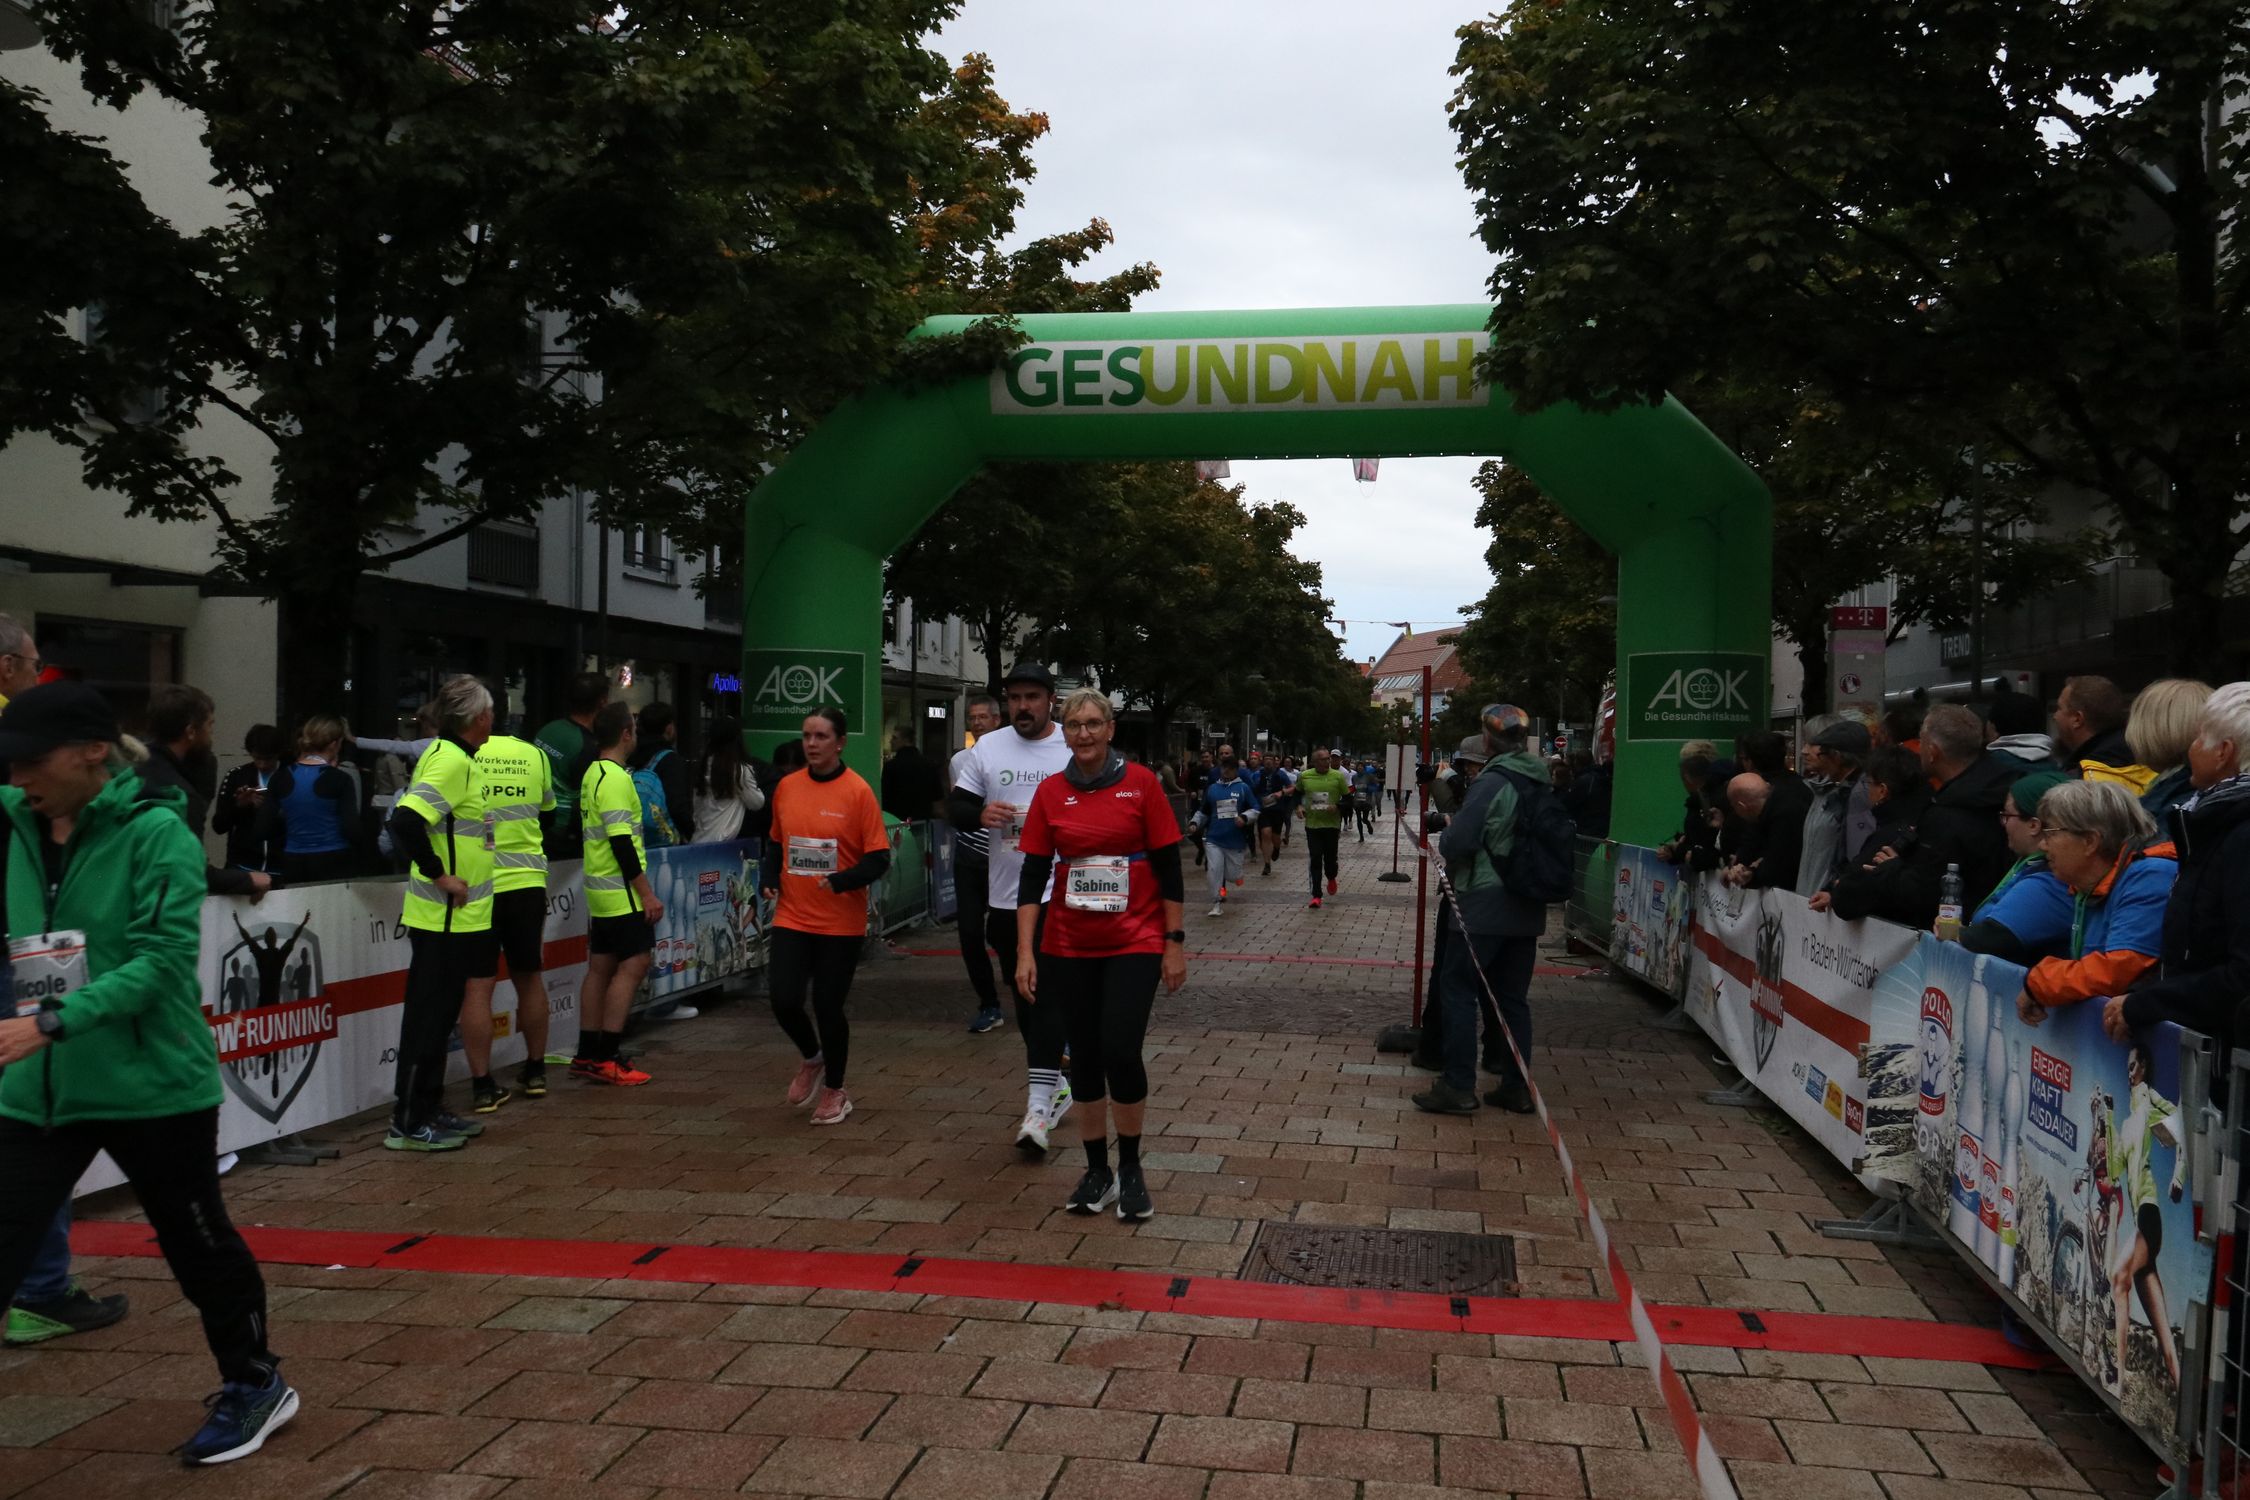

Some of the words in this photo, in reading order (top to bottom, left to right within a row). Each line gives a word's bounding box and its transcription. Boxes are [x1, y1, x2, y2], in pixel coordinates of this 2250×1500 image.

[1005, 339, 1474, 408] GESUNDNAH
[755, 665, 845, 704] AOK
[1648, 668, 1750, 710] AOK
[1645, 711, 1659, 721] Die
[493, 785, 526, 797] PCH
[792, 857, 830, 869] Kathrin
[1075, 879, 1119, 892] Sabine
[370, 913, 386, 944] in
[2033, 1050, 2070, 1088] ENERGIE
[2031, 1075, 2061, 1109] KRAFT
[2029, 1101, 2075, 1147] AUSDAUER
